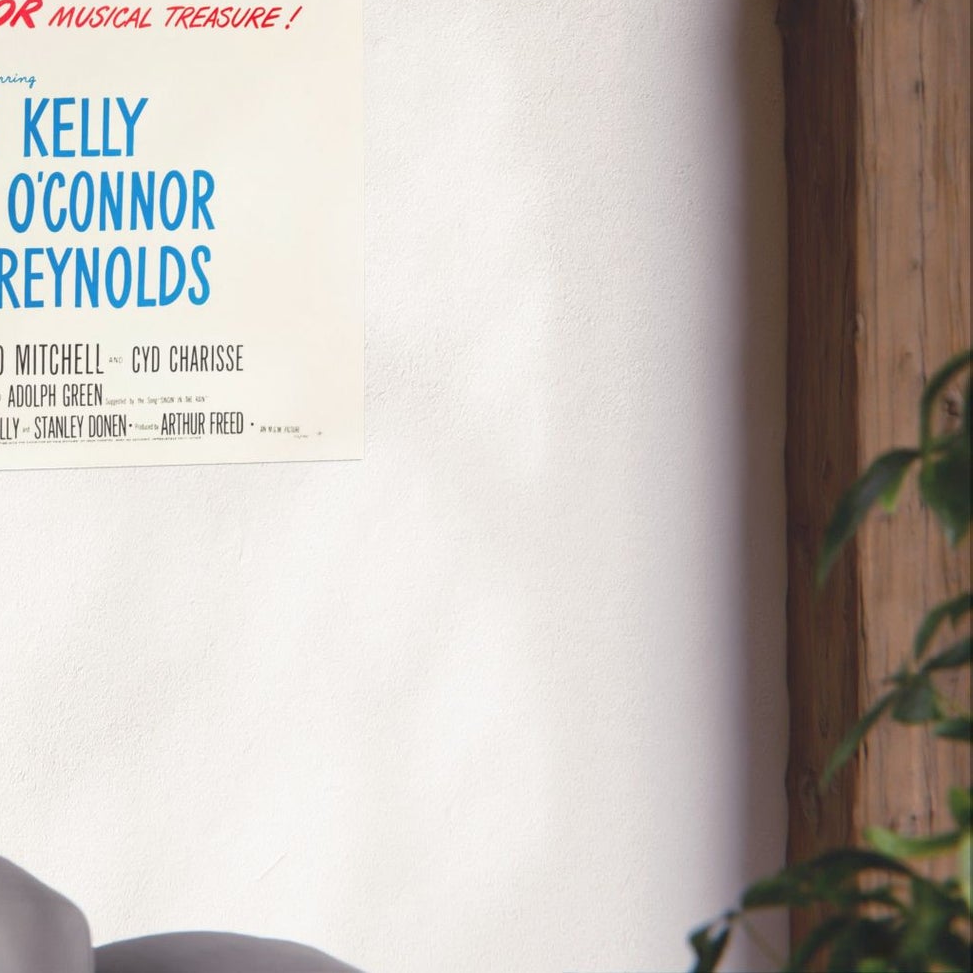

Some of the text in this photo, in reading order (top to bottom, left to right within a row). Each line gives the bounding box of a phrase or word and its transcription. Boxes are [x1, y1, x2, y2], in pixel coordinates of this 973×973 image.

[49, 5, 151, 29] MUSICAL
[24, 97, 147, 157] KELLY
[8, 170, 214, 233] O'CONNOR
[16, 344, 103, 375] MITCHELL
[133, 346, 159, 373] CYD
[170, 345, 243, 372] CHARISSE
[8, 385, 55, 407] ADOLPH
[63, 384, 102, 406] GREEN
[35, 416, 83, 439] STANLEY
[89, 415, 126, 437] DONEN
[161, 413, 205, 435] ARTHUR
[211, 412, 243, 434] FREED
